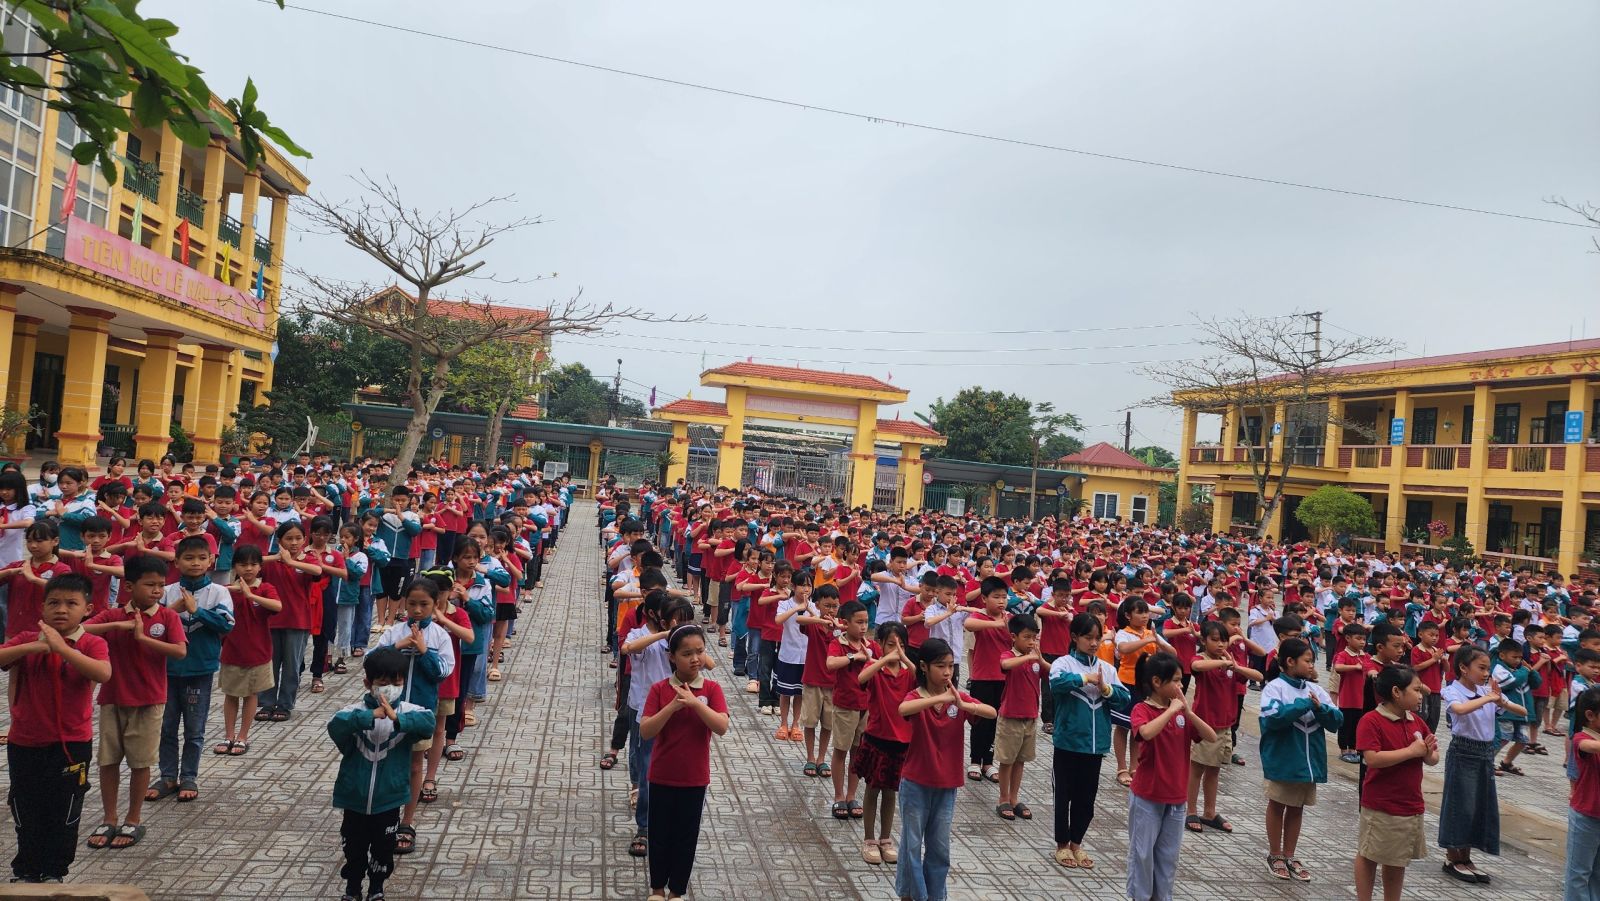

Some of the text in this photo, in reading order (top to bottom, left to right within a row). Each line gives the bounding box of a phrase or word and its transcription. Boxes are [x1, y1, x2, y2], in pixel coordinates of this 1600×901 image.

[82, 235, 123, 272] TIÊN
[129, 254, 162, 286] HỌC
[1469, 366, 1513, 380] TẤT
[1525, 360, 1556, 376] CẢ
